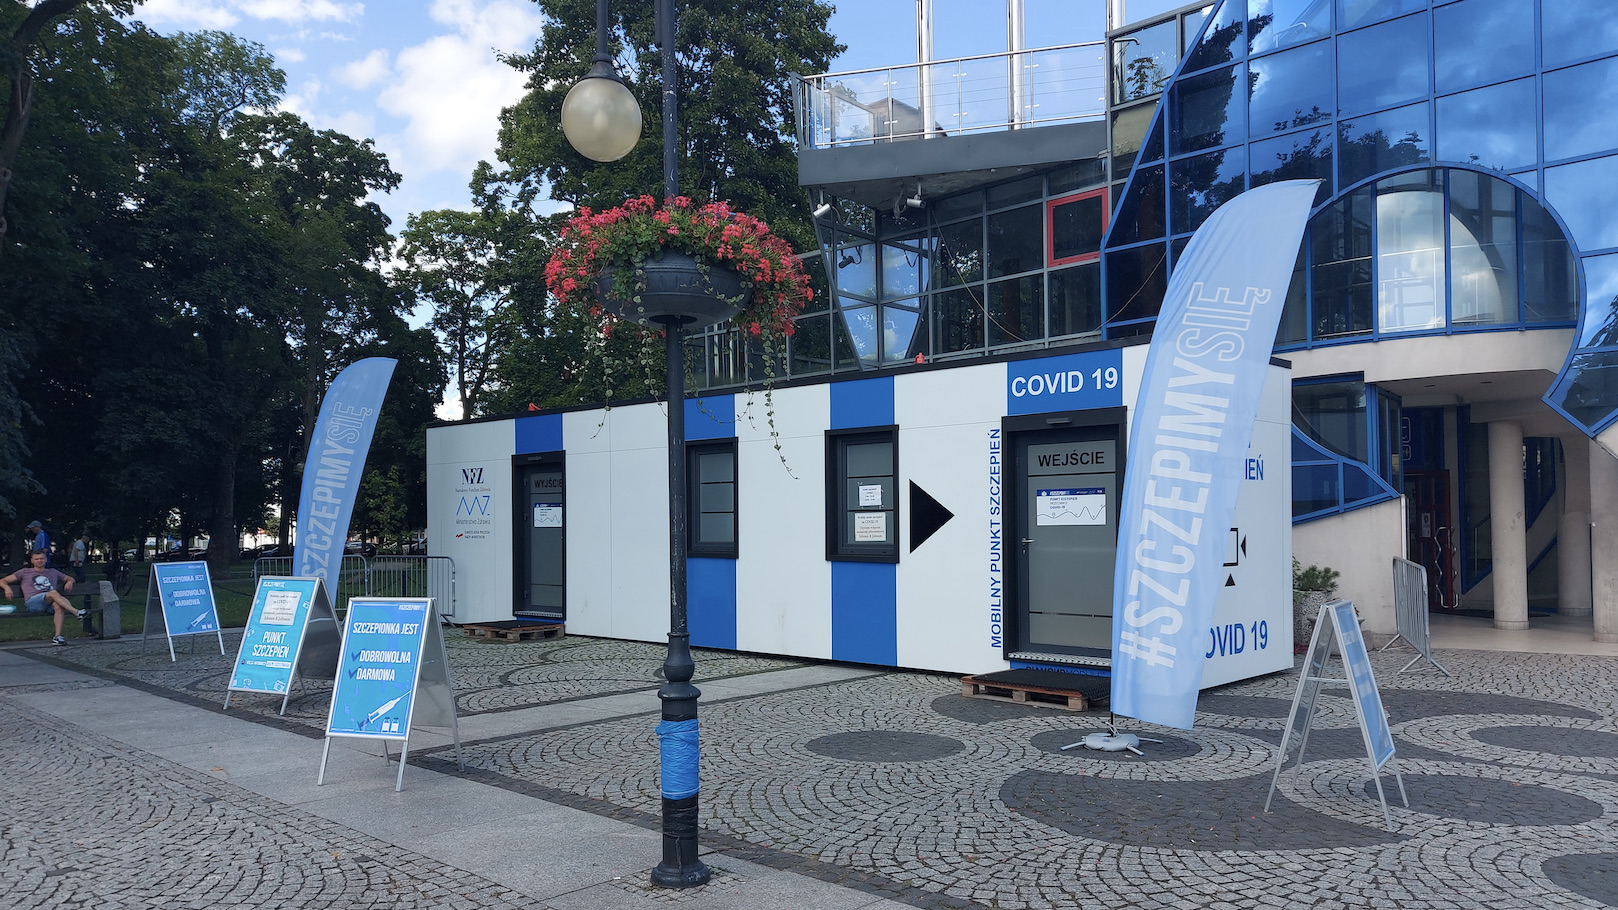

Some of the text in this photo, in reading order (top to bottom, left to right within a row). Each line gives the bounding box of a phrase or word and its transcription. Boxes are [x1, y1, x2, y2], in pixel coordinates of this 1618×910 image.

[1011, 367, 1119, 397] COVID 19
[1038, 449, 1105, 467] WEJŚCIE
[461, 467, 484, 485] NFZ
[534, 476, 563, 488] WYJŚCIE
[1119, 281, 1272, 669] #SZCZEPIMYSIĘ
[301, 402, 373, 577] SZCZEPIMYSIĘ
[987, 428, 1002, 648] MOBILNY PUNKT SZCZEPIEŃ
[162, 575, 194, 583] SZCZEPIONKA
[172, 588, 206, 598] DOBROWOLNA
[174, 598, 201, 607] DARMOWA
[352, 622, 419, 635] SZCZEPIONKA JEST
[262, 631, 287, 644] PUNKT
[1205, 620, 1268, 659] OVID 19
[251, 643, 290, 659] SZCZEPIEŃ
[359, 650, 411, 664] DOBROWOLNA
[355, 668, 395, 681] DARMOWA
